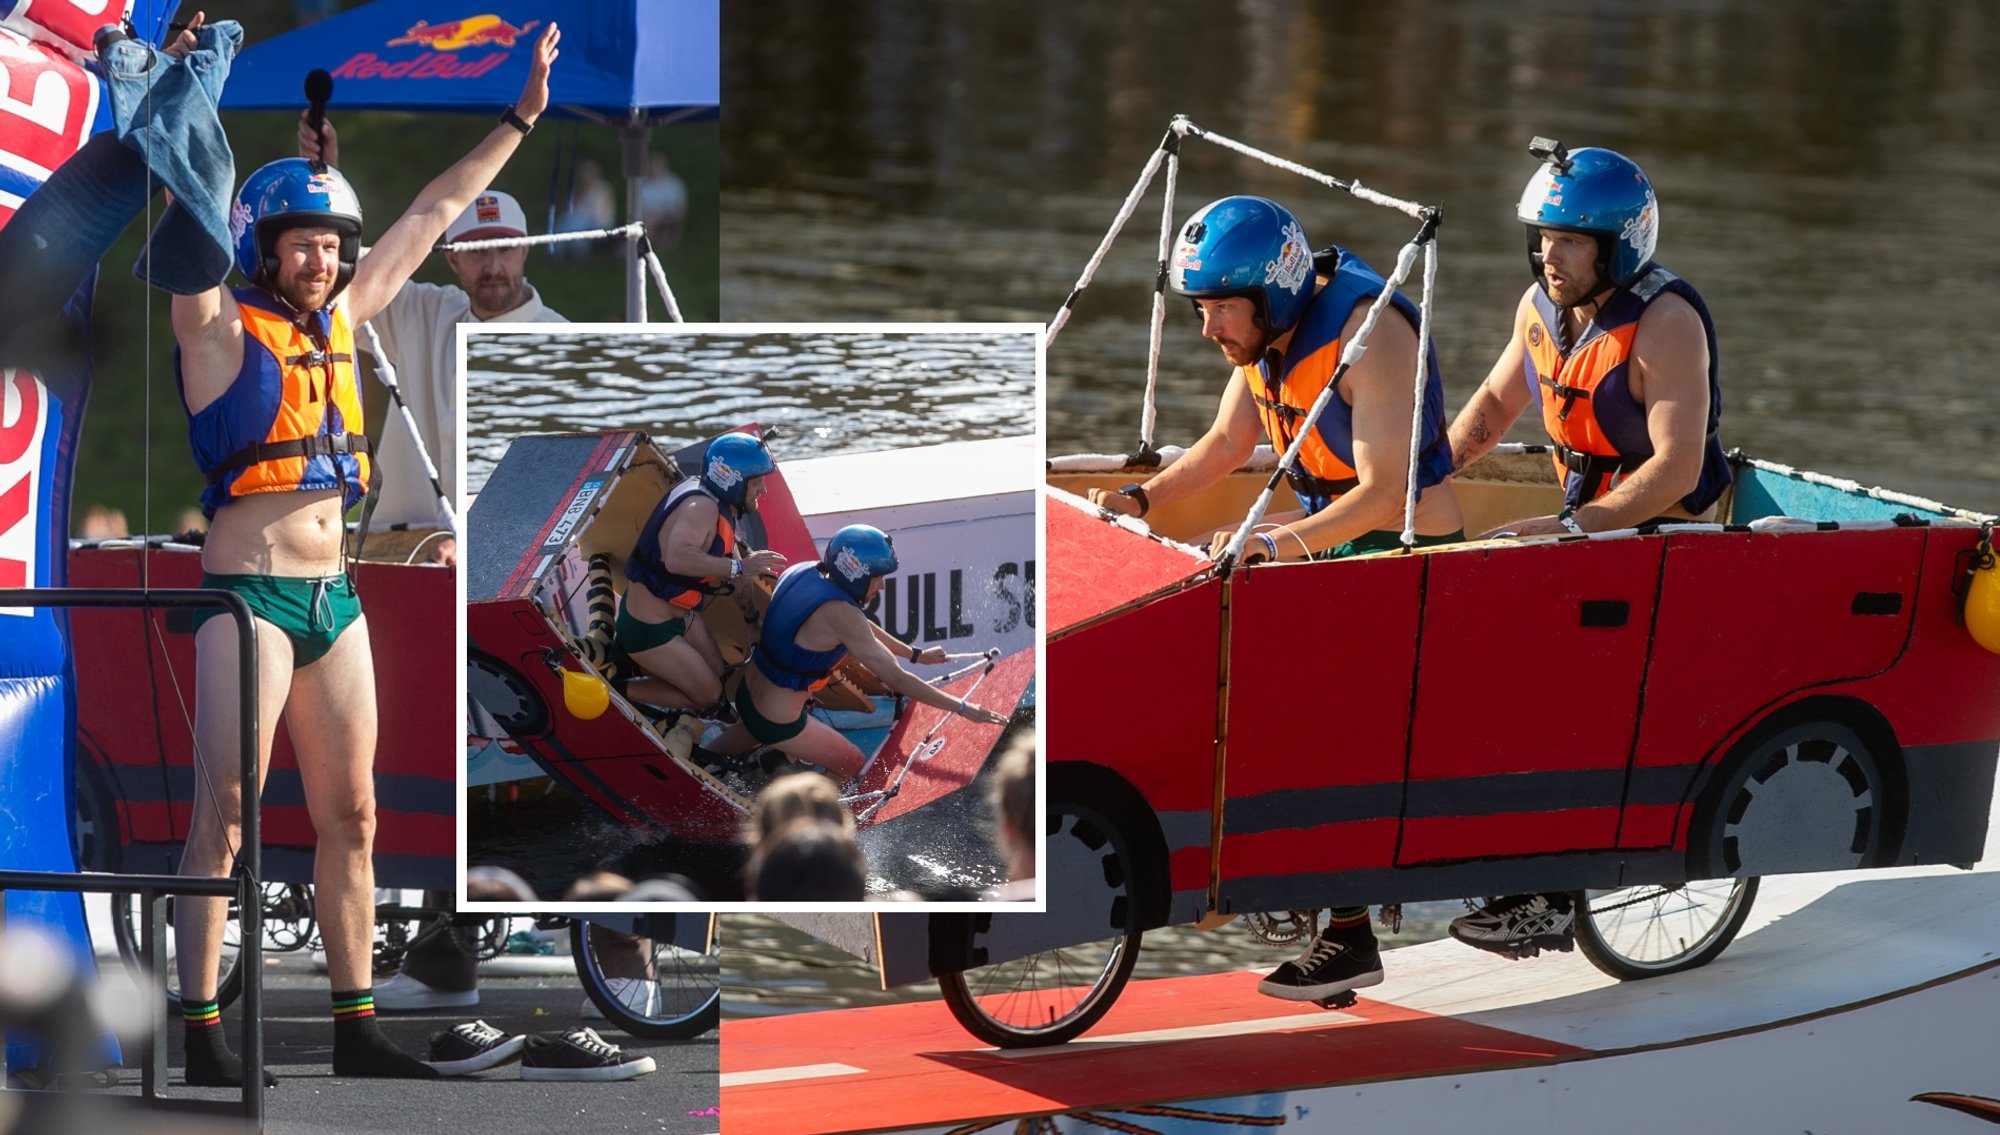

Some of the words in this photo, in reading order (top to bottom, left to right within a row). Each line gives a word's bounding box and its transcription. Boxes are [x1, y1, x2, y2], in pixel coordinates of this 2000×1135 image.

[330, 53, 432, 78] Red
[408, 53, 510, 78] Bull
[567, 490, 593, 514] BNB
